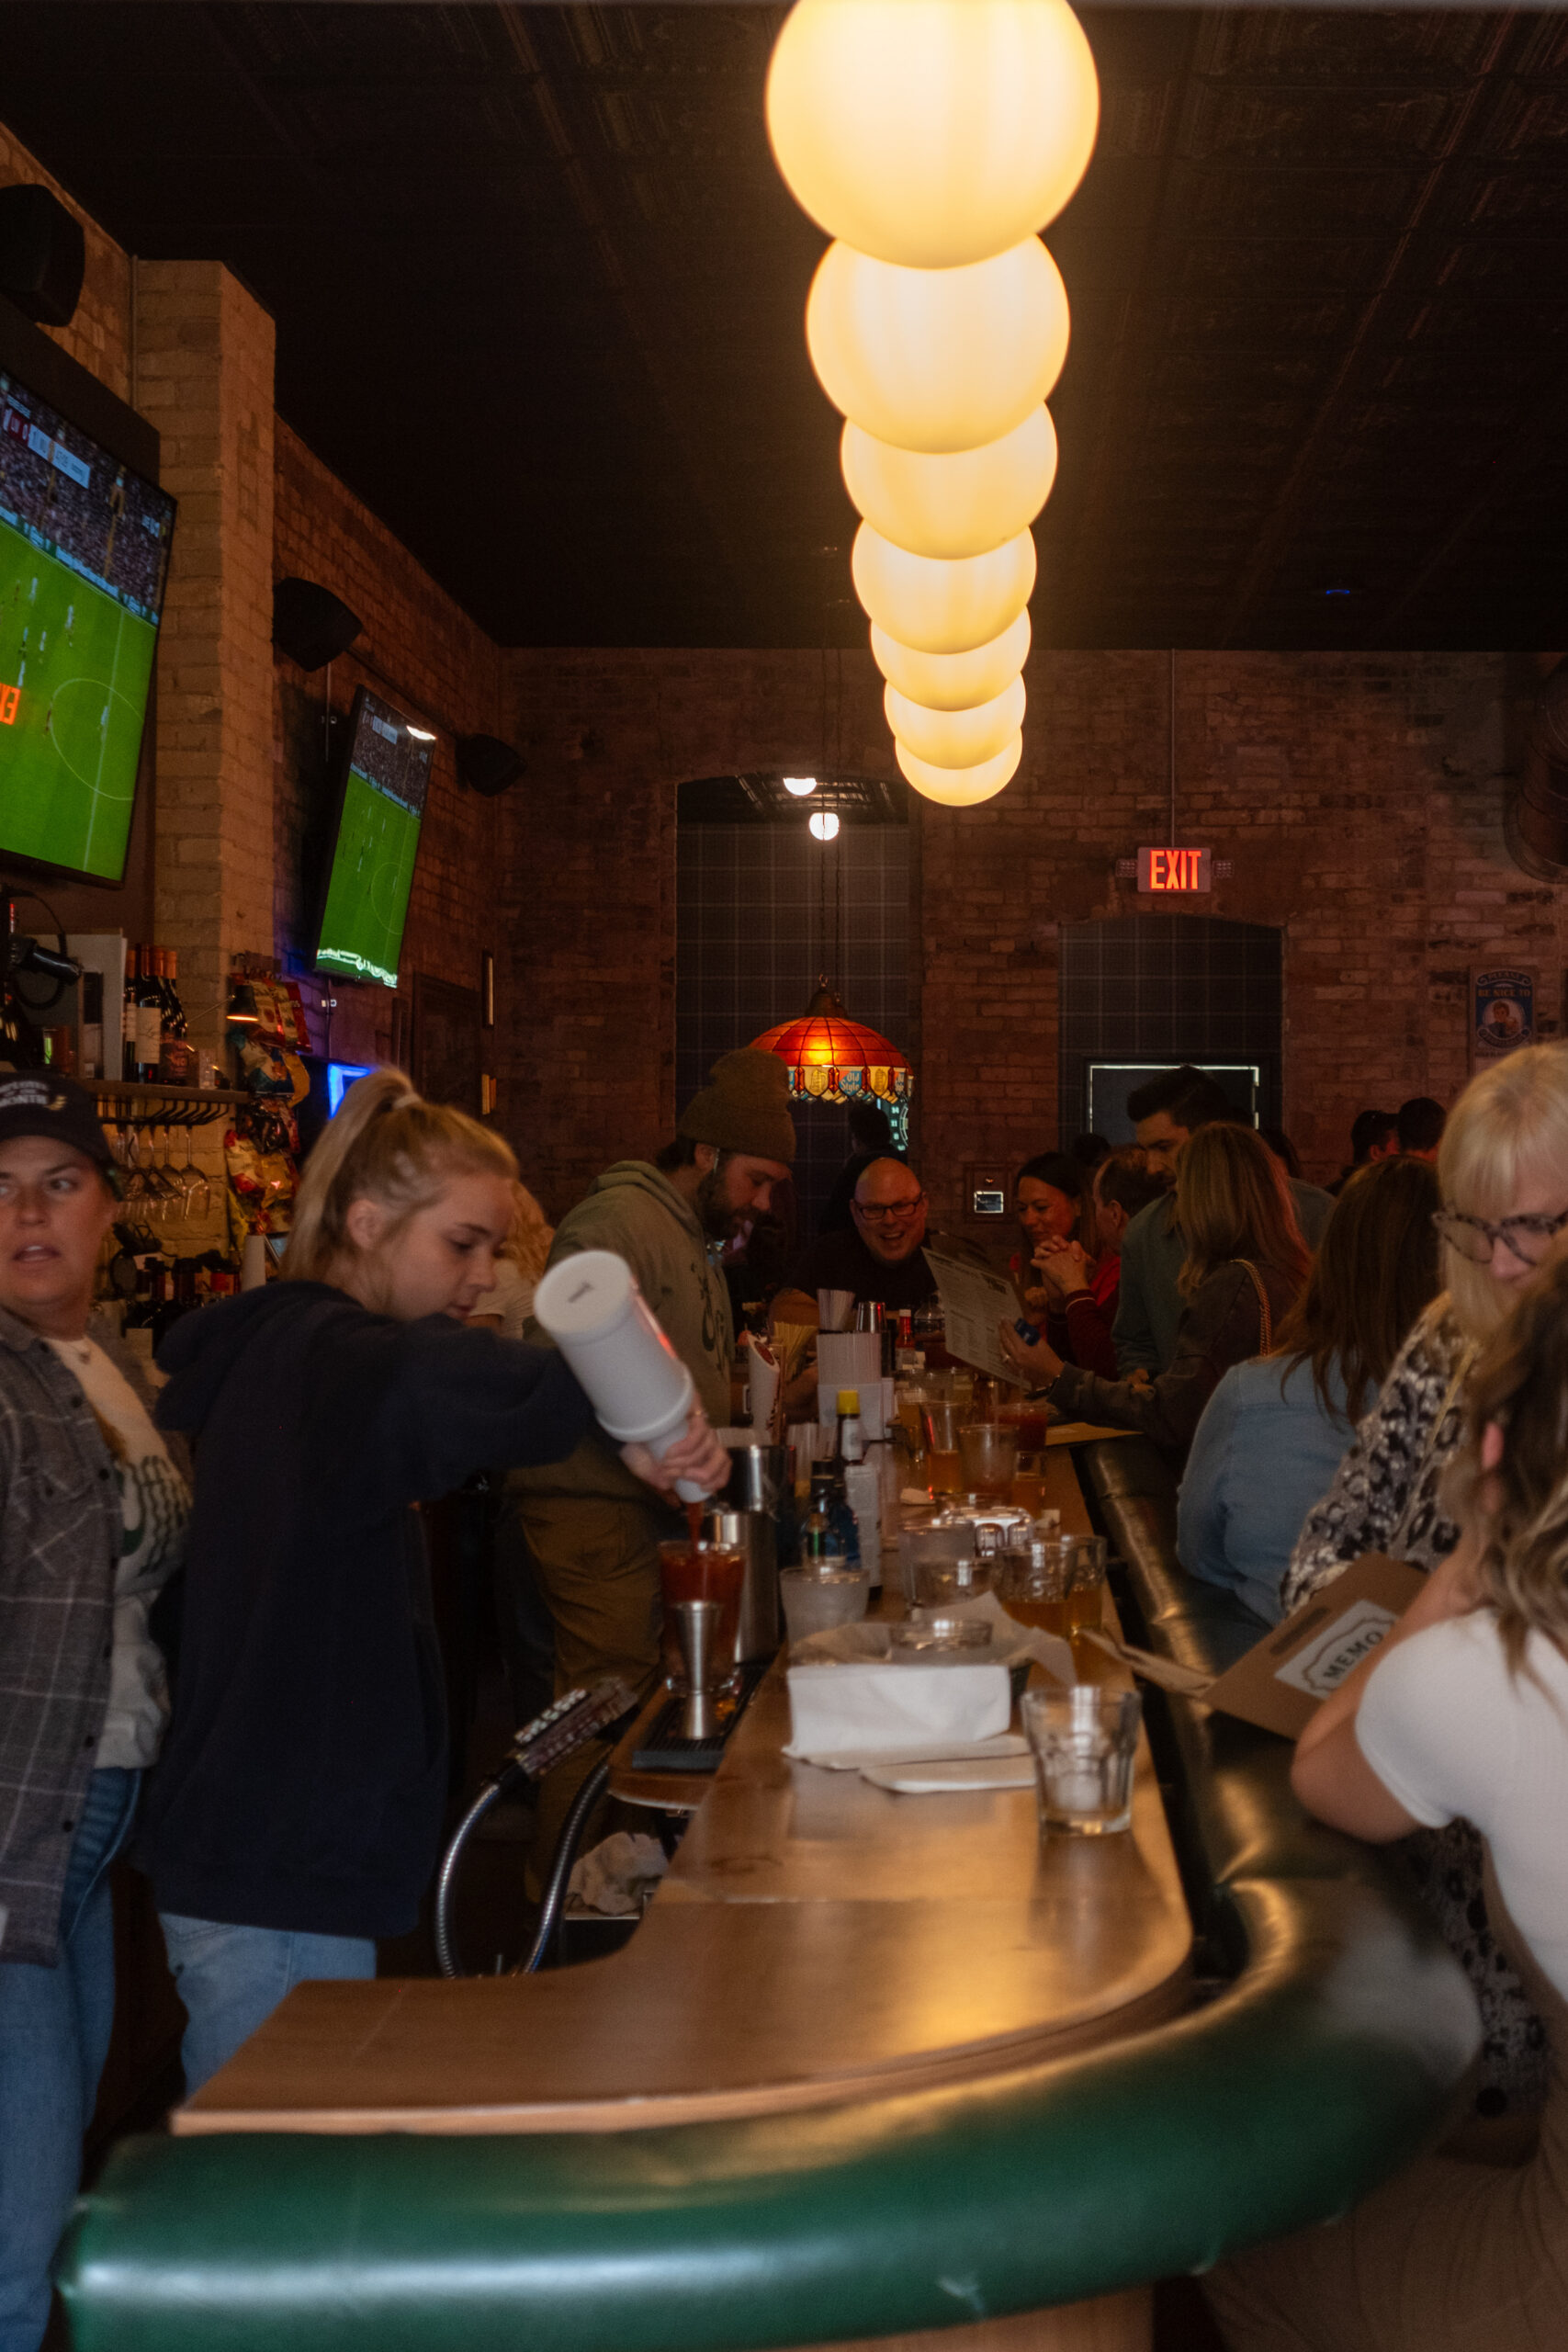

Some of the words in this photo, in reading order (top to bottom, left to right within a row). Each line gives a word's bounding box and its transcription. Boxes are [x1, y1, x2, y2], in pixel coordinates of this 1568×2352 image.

[1150, 850, 1202, 889] EXIT
[1487, 971, 1520, 980] PLEASE
[1478, 989, 1491, 997] BE
[1493, 989, 1516, 997] NICE
[1519, 989, 1531, 997] TO
[847, 1072, 860, 1082] Old
[840, 1080, 860, 1094] Style
